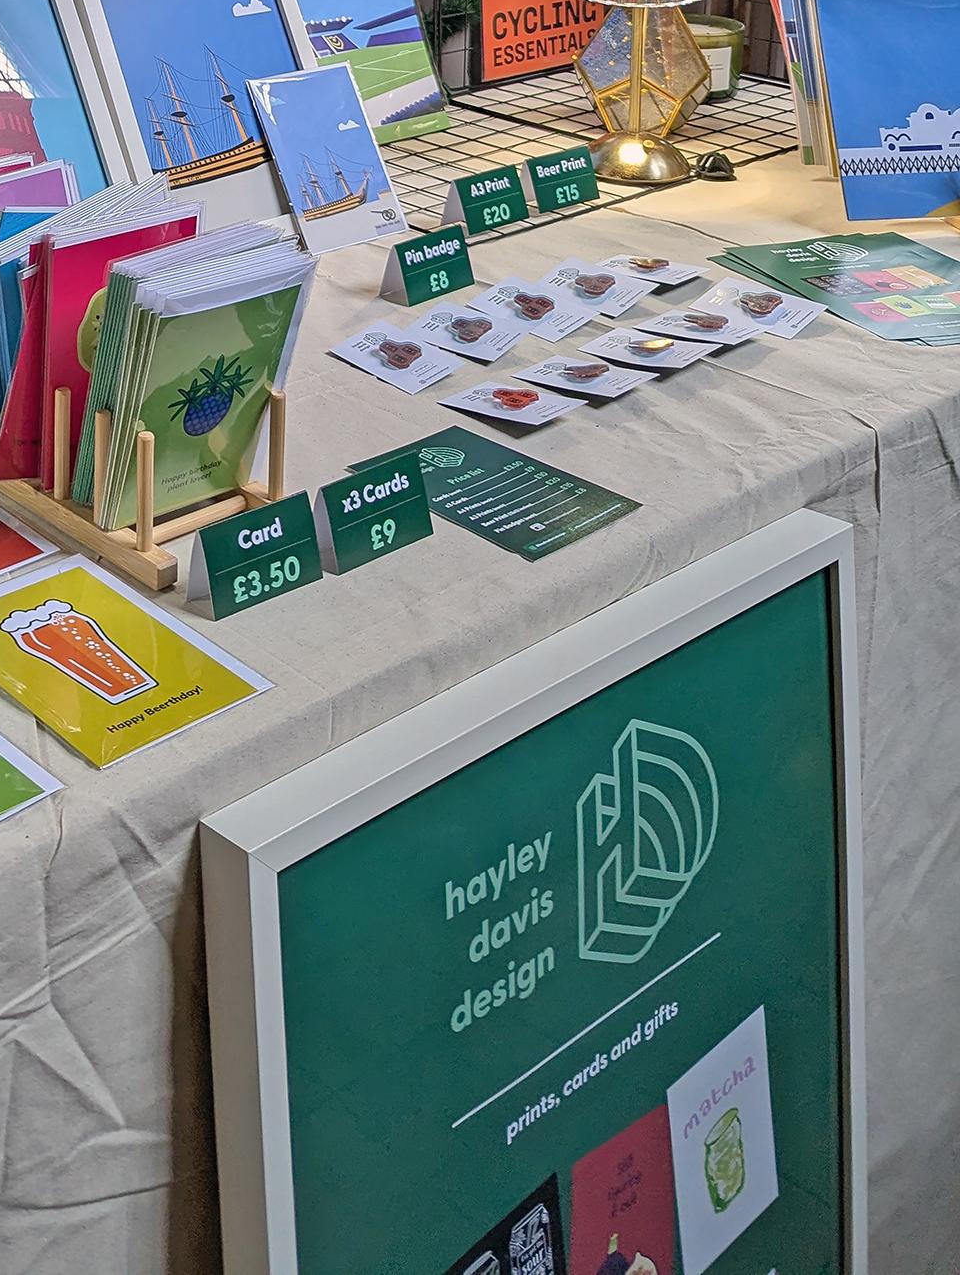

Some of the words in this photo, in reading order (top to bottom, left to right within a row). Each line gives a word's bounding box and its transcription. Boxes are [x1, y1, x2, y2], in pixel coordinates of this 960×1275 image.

[492, 0, 596, 40] CYCLING
[536, 163, 560, 179] Beer
[561, 156, 587, 173] Print
[470, 181, 485, 198] A3
[485, 175, 511, 193] Print
[556, 183, 580, 205] £15
[483, 203, 510, 226] £20
[405, 249, 424, 266] Pin
[423, 237, 461, 261] badge
[429, 270, 449, 292] £8
[160, 472, 188, 486] Happy
[189, 460, 223, 477] birthday
[167, 480, 189, 494] plant
[189, 471, 213, 484] lover!
[341, 490, 361, 514] x3
[362, 472, 410, 503] Cards
[237, 516, 283, 550] Card
[370, 519, 396, 551] £9
[233, 555, 300, 604] £3.50
[106, 713, 145, 734] Happy
[144, 685, 204, 717] Beerthday!
[445, 831, 553, 921] hayley
[468, 887, 554, 963] davis
[450, 946, 555, 1033] design
[506, 1095, 561, 1145] prints,
[562, 1052, 608, 1097] cards
[610, 1022, 642, 1062] and
[644, 1001, 680, 1042] gifts
[682, 1054, 758, 1139] matcha
